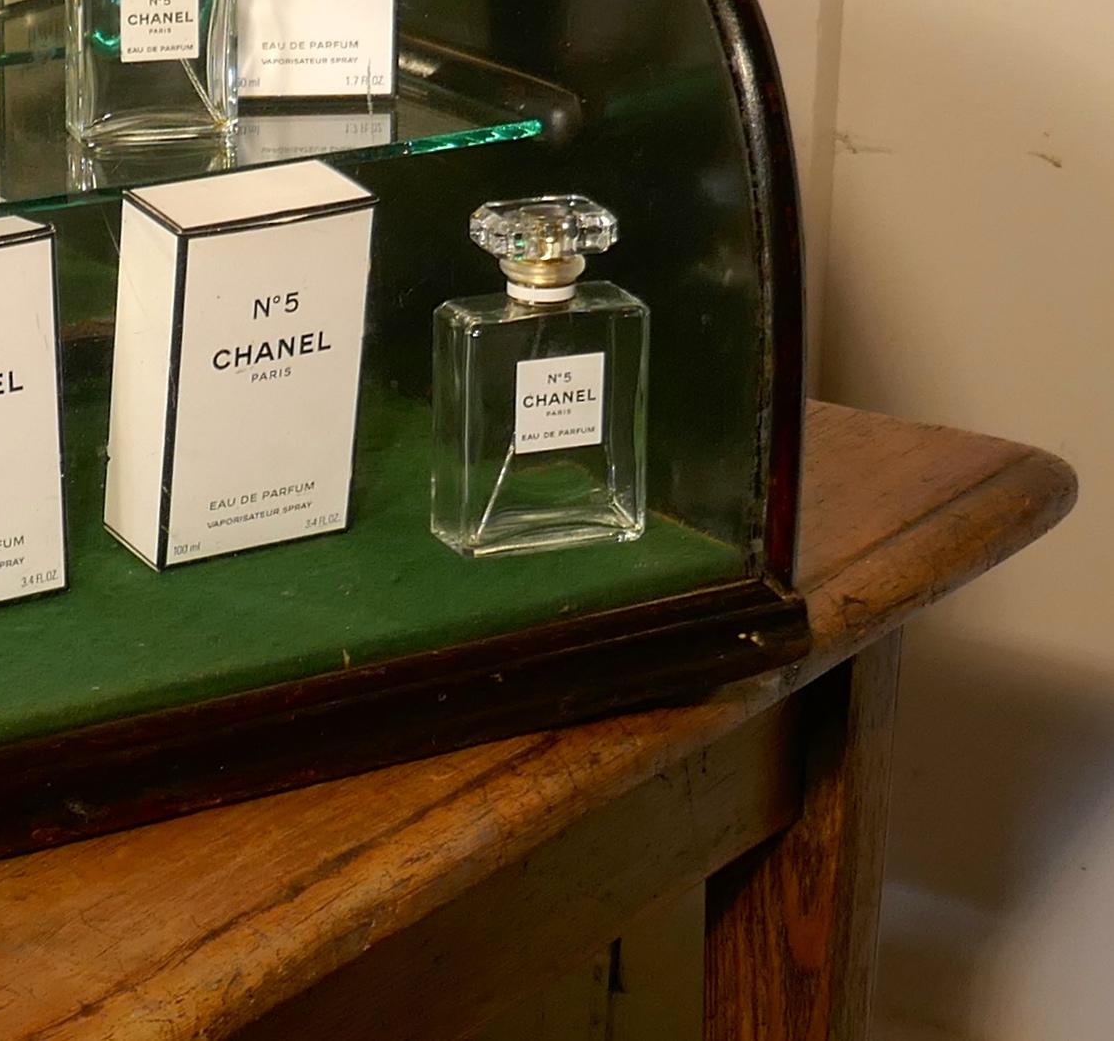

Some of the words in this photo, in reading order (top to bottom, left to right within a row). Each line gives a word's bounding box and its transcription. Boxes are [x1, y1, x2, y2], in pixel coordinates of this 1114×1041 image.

[127, 12, 193, 25] CHANEL
[160, 44, 194, 52] PARFUM
[262, 41, 285, 51] EAU
[290, 41, 306, 50] DE
[309, 40, 359, 50] PARFUM
[261, 57, 328, 65] VAPORISATEUR
[248, 77, 261, 88] ml
[212, 331, 331, 371] CHANEL
[251, 367, 292, 383] PARIS
[523, 389, 596, 408] CHANEL
[558, 426, 595, 436] PARFUM
[209, 498, 236, 511] EAU
[240, 492, 257, 505] DE
[262, 481, 316, 500] PARFUM
[207, 507, 280, 529] VAPORISATEUR
[282, 502, 313, 514] SPRAY
[173, 544, 188, 556] 100
[189, 542, 201, 553] ml
